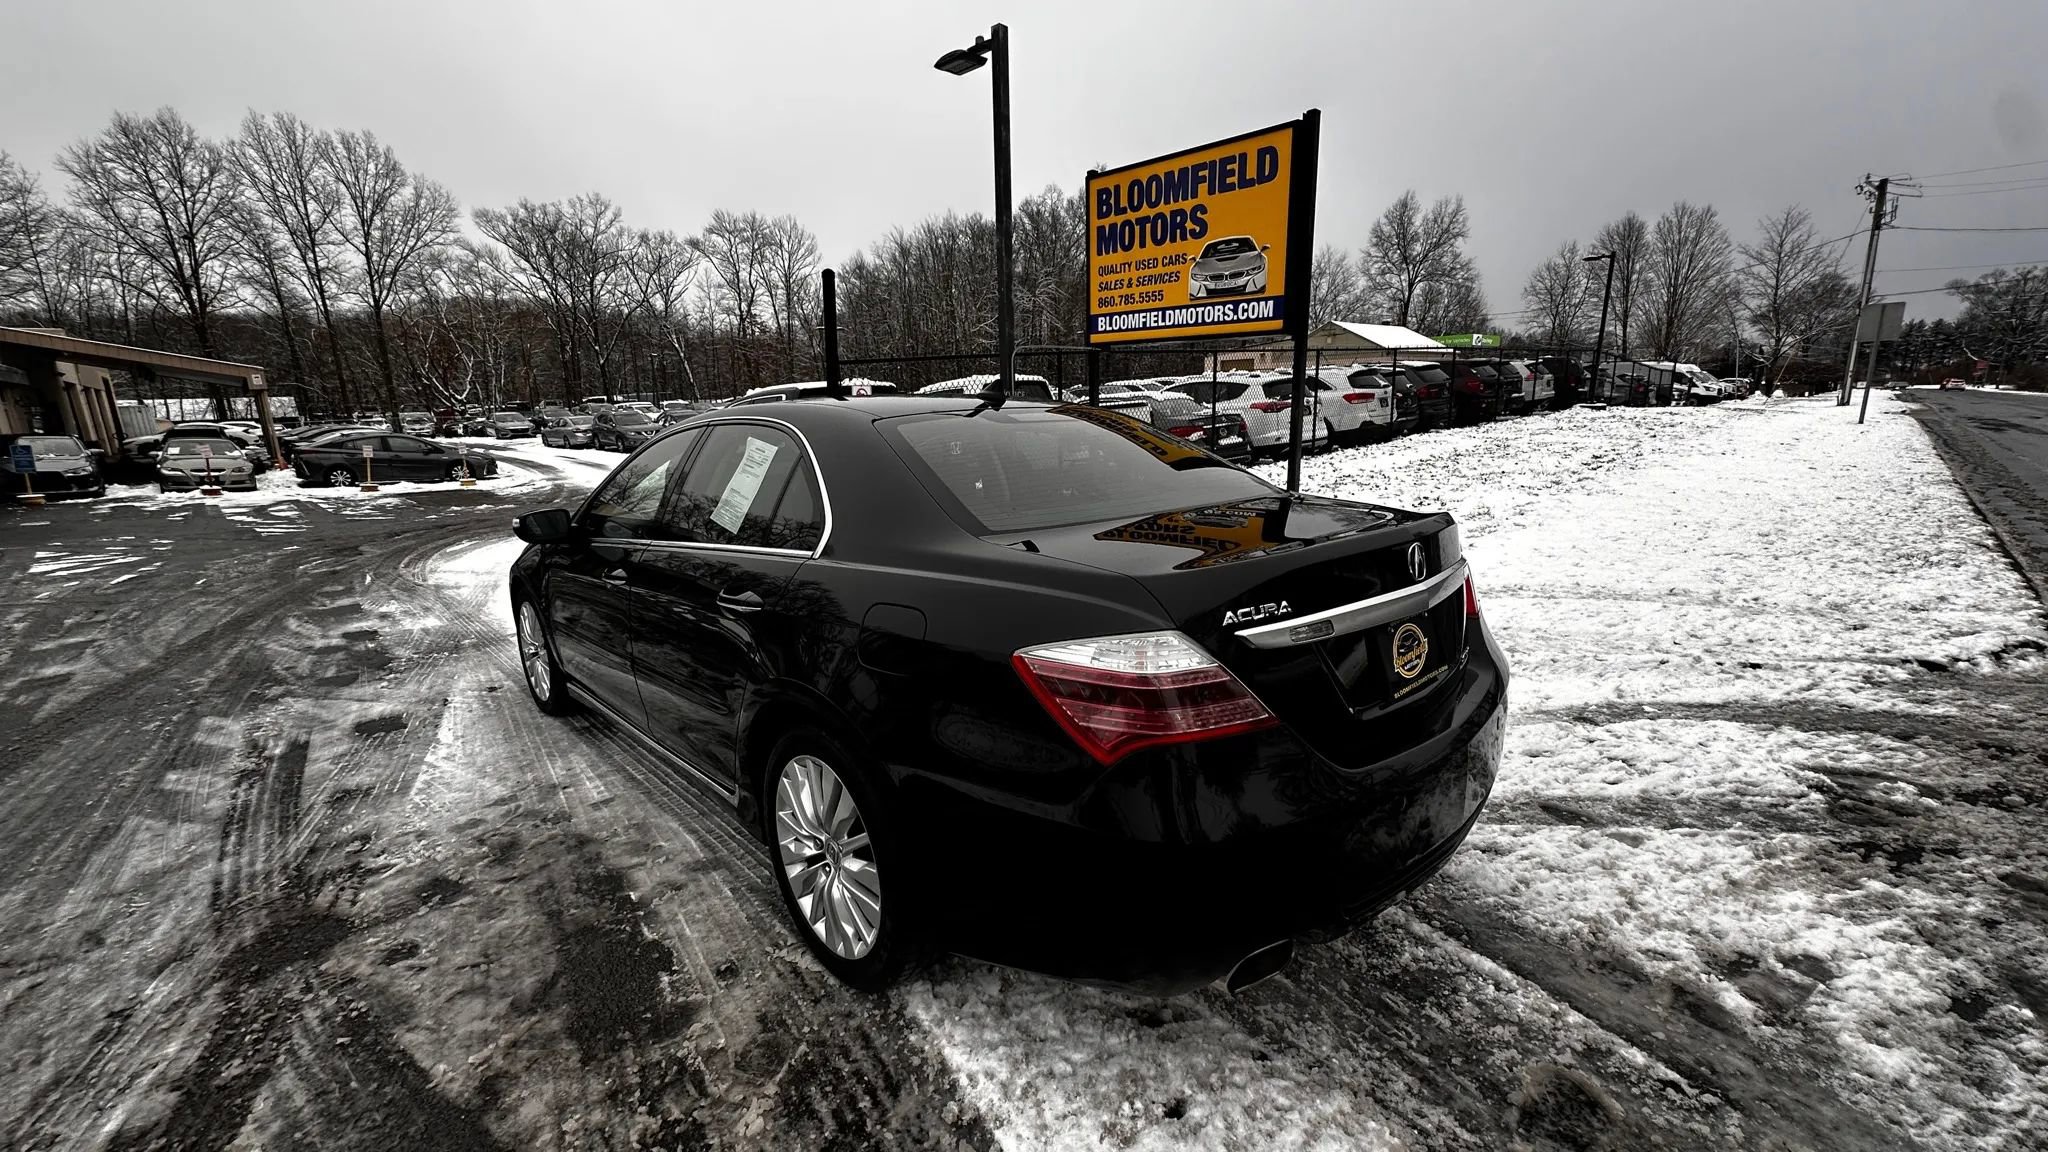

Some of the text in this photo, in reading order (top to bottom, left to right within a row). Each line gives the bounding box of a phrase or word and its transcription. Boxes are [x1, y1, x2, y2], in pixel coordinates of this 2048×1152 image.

[1096, 145, 1279, 220] BLOOMFIELD
[1096, 204, 1208, 256] MOTORS
[1098, 253, 1187, 277] QUALITY USED CARS
[1098, 271, 1181, 292] SALES & SERVICES
[1098, 290, 1164, 308] 860.785.5555
[1098, 300, 1273, 331] BLOOMFIELDMOTORS.COM
[1222, 600, 1292, 626] ACURA
[1394, 665, 1448, 698] BLOOMFIELDMOTORS.COM
